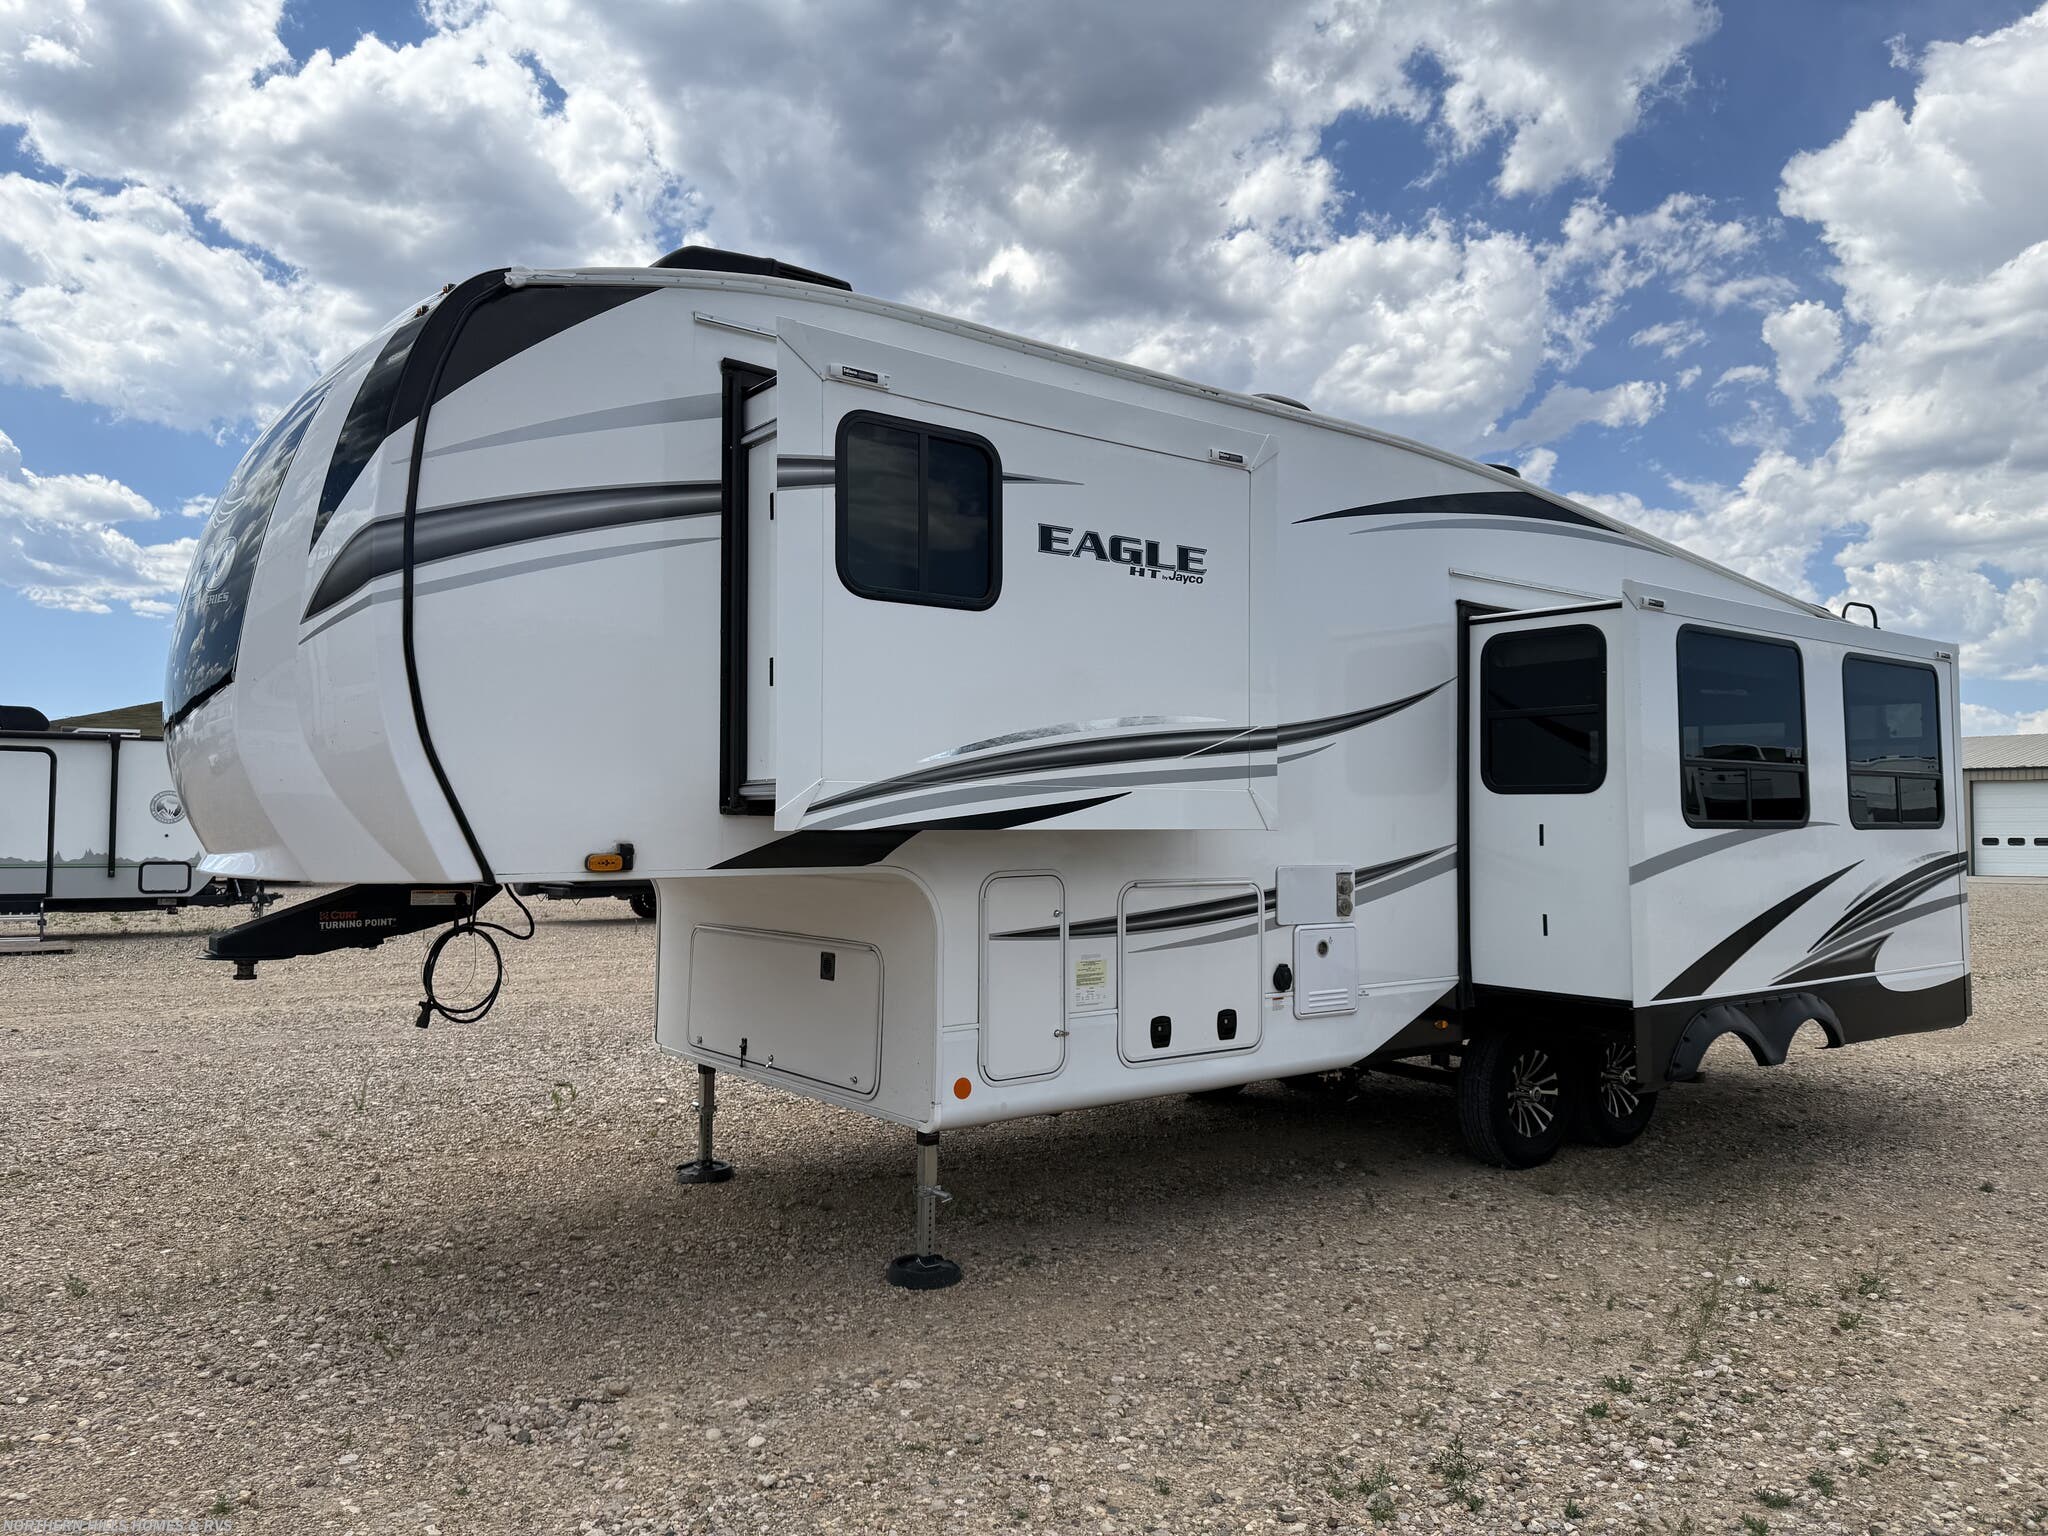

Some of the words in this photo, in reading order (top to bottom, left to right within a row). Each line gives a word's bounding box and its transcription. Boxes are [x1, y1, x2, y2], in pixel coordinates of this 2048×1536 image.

[1038, 523, 1207, 575] EAGLE
[1130, 566, 1161, 579] HT
[1168, 571, 1204, 585] Jayco
[319, 919, 362, 930] TURNING
